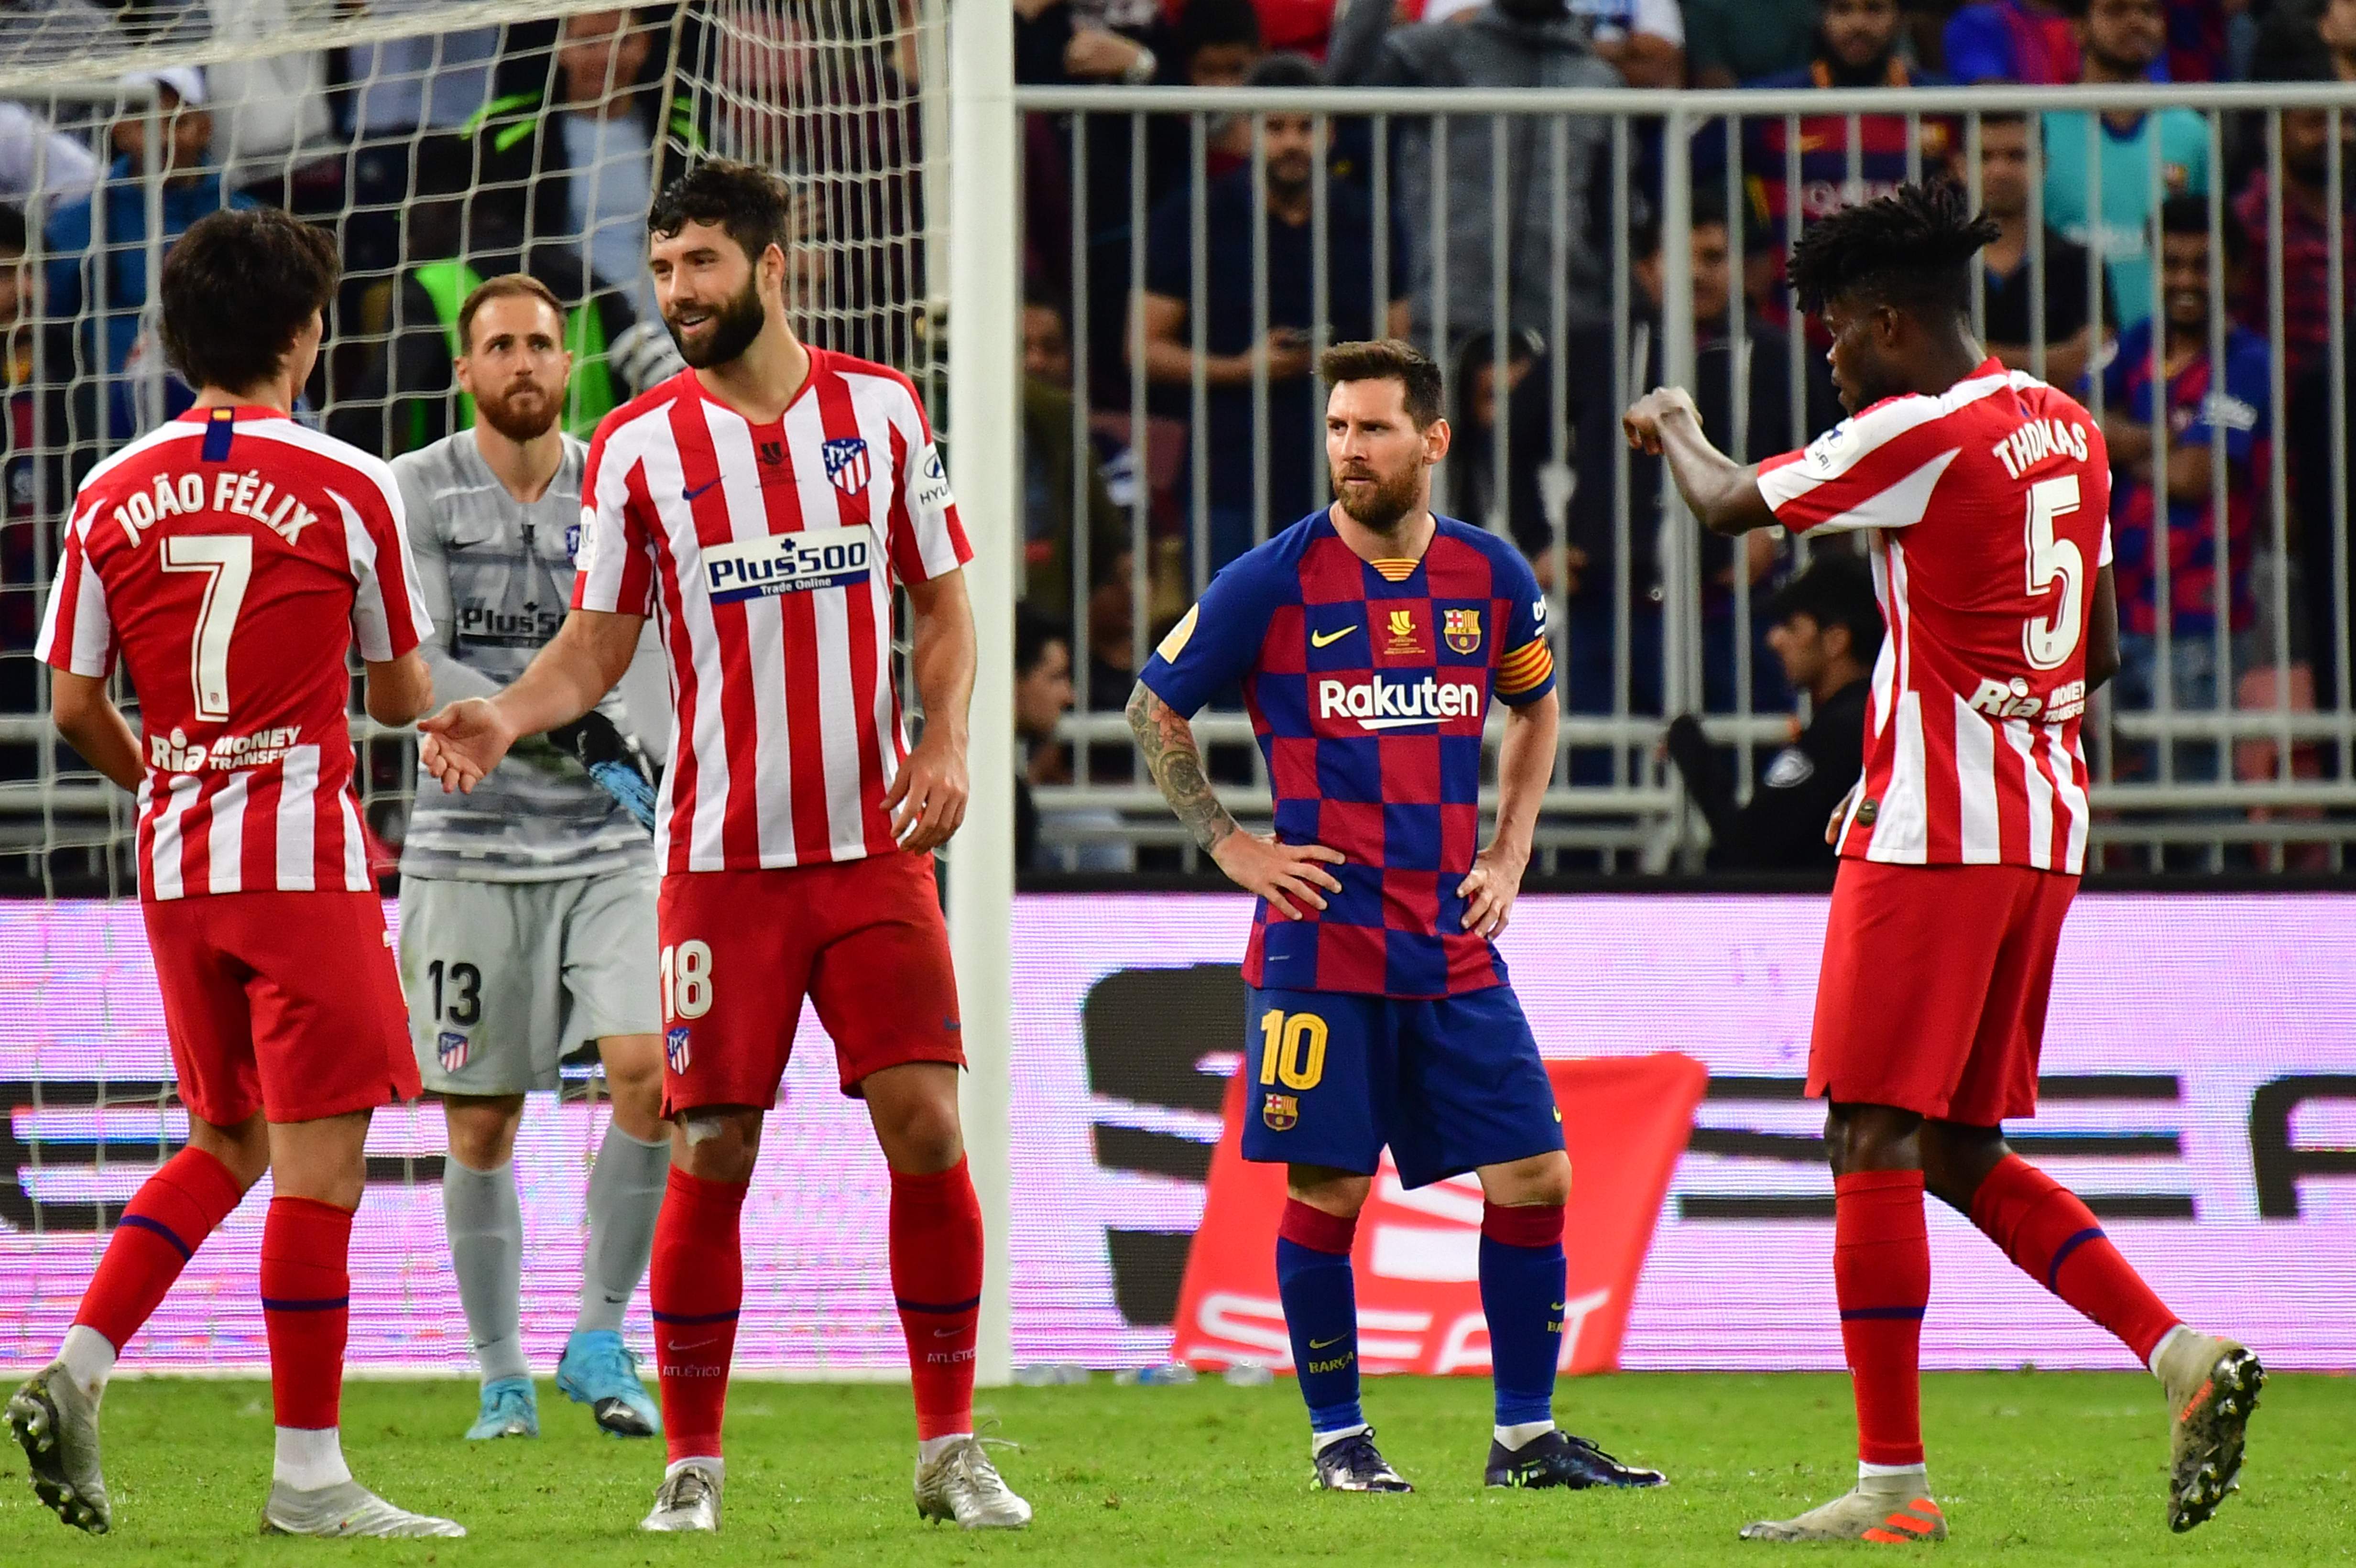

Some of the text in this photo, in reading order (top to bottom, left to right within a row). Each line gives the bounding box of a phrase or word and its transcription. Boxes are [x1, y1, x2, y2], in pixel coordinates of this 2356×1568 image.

[1992, 417, 2088, 480] THOMAS
[113, 469, 319, 549] JOÃO FÉLIX
[709, 541, 867, 588] Plus500
[760, 577, 832, 596] Trade Online
[2022, 474, 2083, 670] 5
[160, 534, 253, 723] 7
[462, 608, 566, 634] Plus5
[1319, 675, 1479, 719] Rakuten
[1968, 676, 2042, 718] Ria
[150, 727, 207, 772] Ria
[210, 725, 302, 755] MONEY
[428, 959, 481, 1027] 13
[661, 939, 713, 1023] 18
[1260, 1009, 1329, 1090] 10
[663, 1364, 720, 1377] ATLÉTICO
